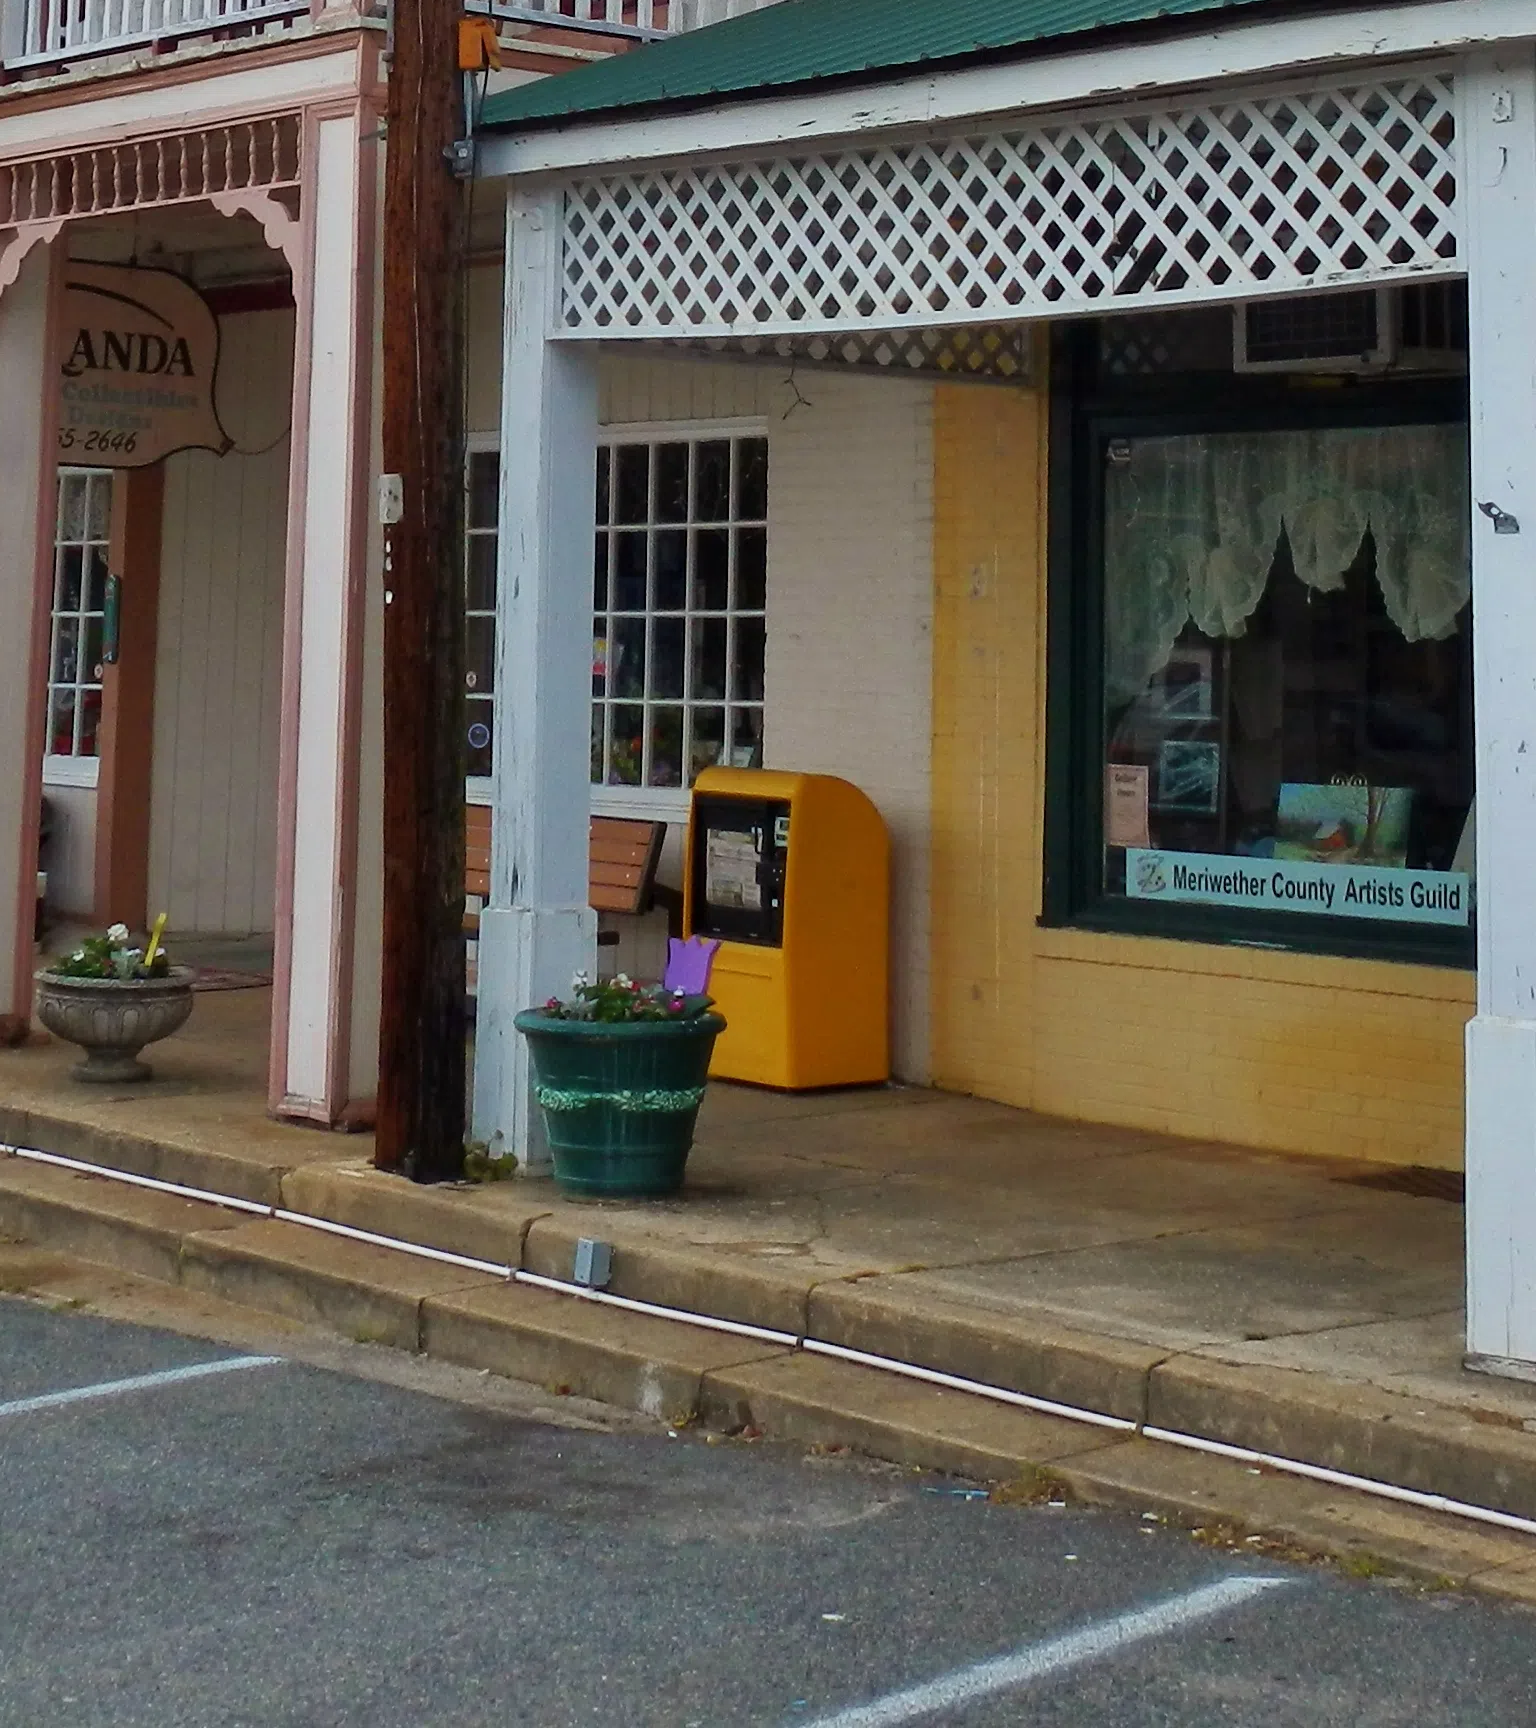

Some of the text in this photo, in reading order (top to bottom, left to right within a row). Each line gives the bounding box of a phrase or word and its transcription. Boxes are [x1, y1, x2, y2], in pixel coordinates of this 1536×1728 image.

[1172, 864, 1461, 911] Meriwether County Artists Guild
